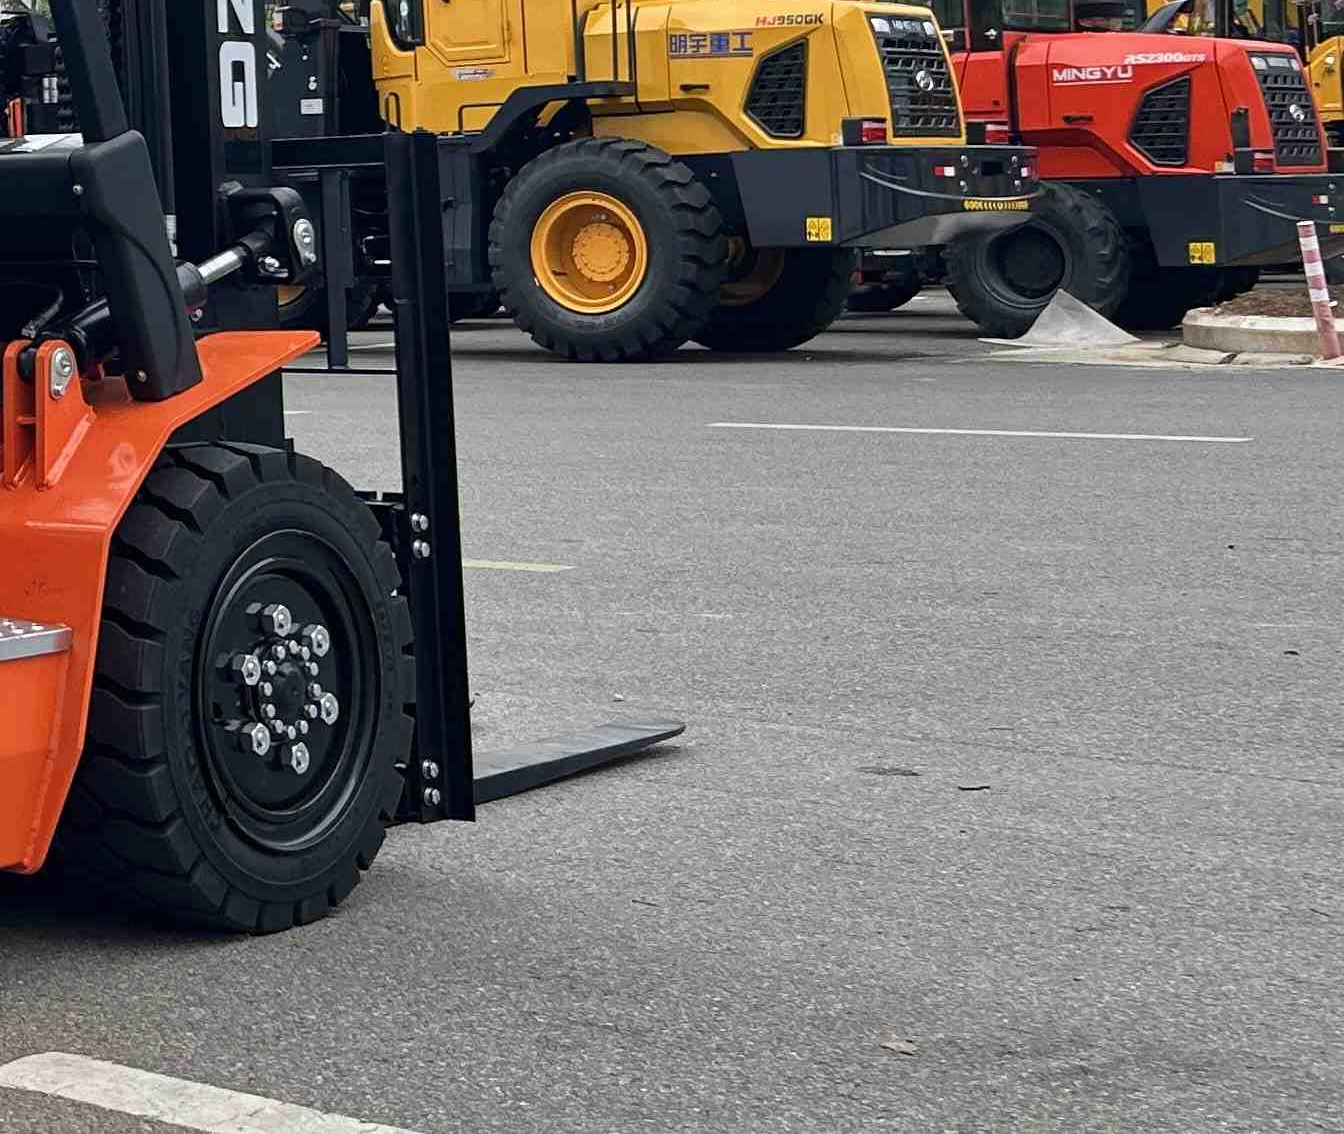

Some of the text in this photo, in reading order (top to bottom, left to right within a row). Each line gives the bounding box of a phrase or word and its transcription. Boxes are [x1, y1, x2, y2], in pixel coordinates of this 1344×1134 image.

[755, 13, 824, 27] HJ950GK
[669, 32, 753, 54] 明宇重工
[1052, 66, 1133, 82] MINGYU
